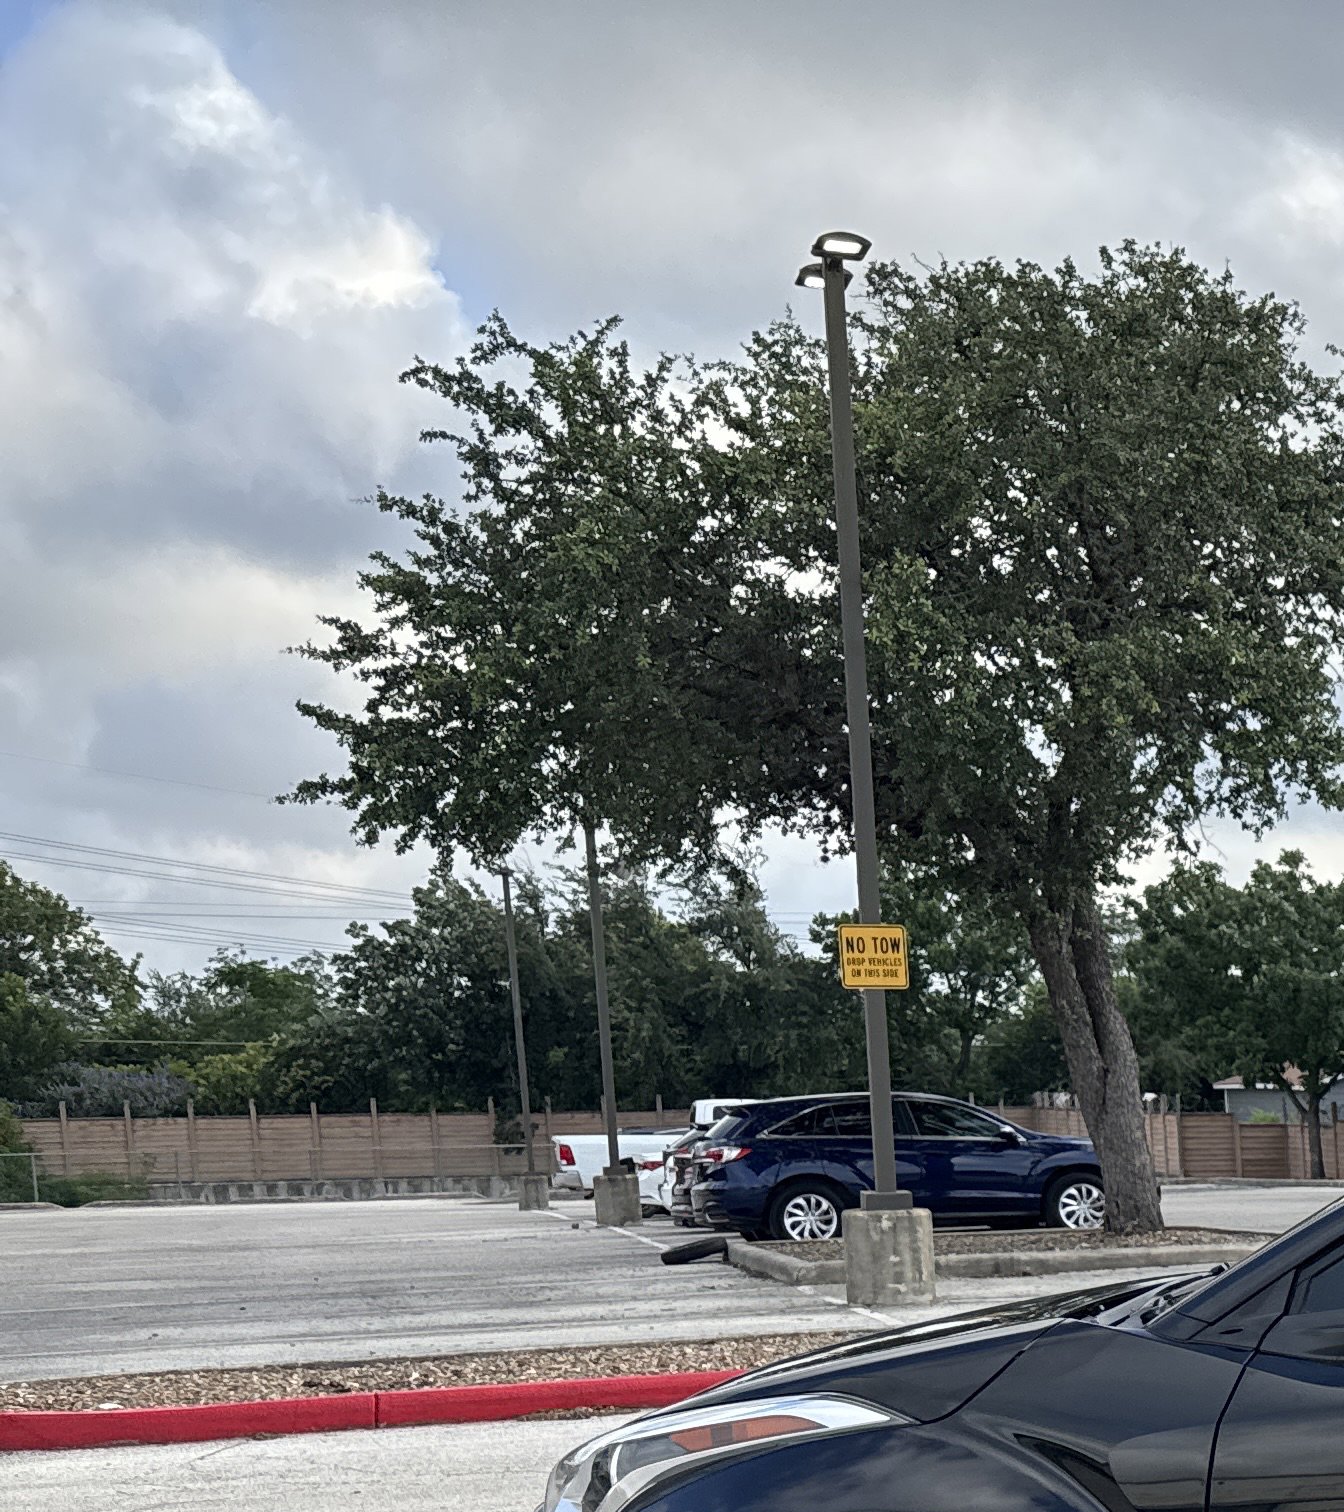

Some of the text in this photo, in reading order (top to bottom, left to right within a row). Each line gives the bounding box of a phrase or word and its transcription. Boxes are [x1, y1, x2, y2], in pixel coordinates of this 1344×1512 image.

[845, 936, 900, 954] NO TOW
[846, 957, 902, 966] DROP VEHICLES
[851, 968, 899, 978] ON THIS SIDE
